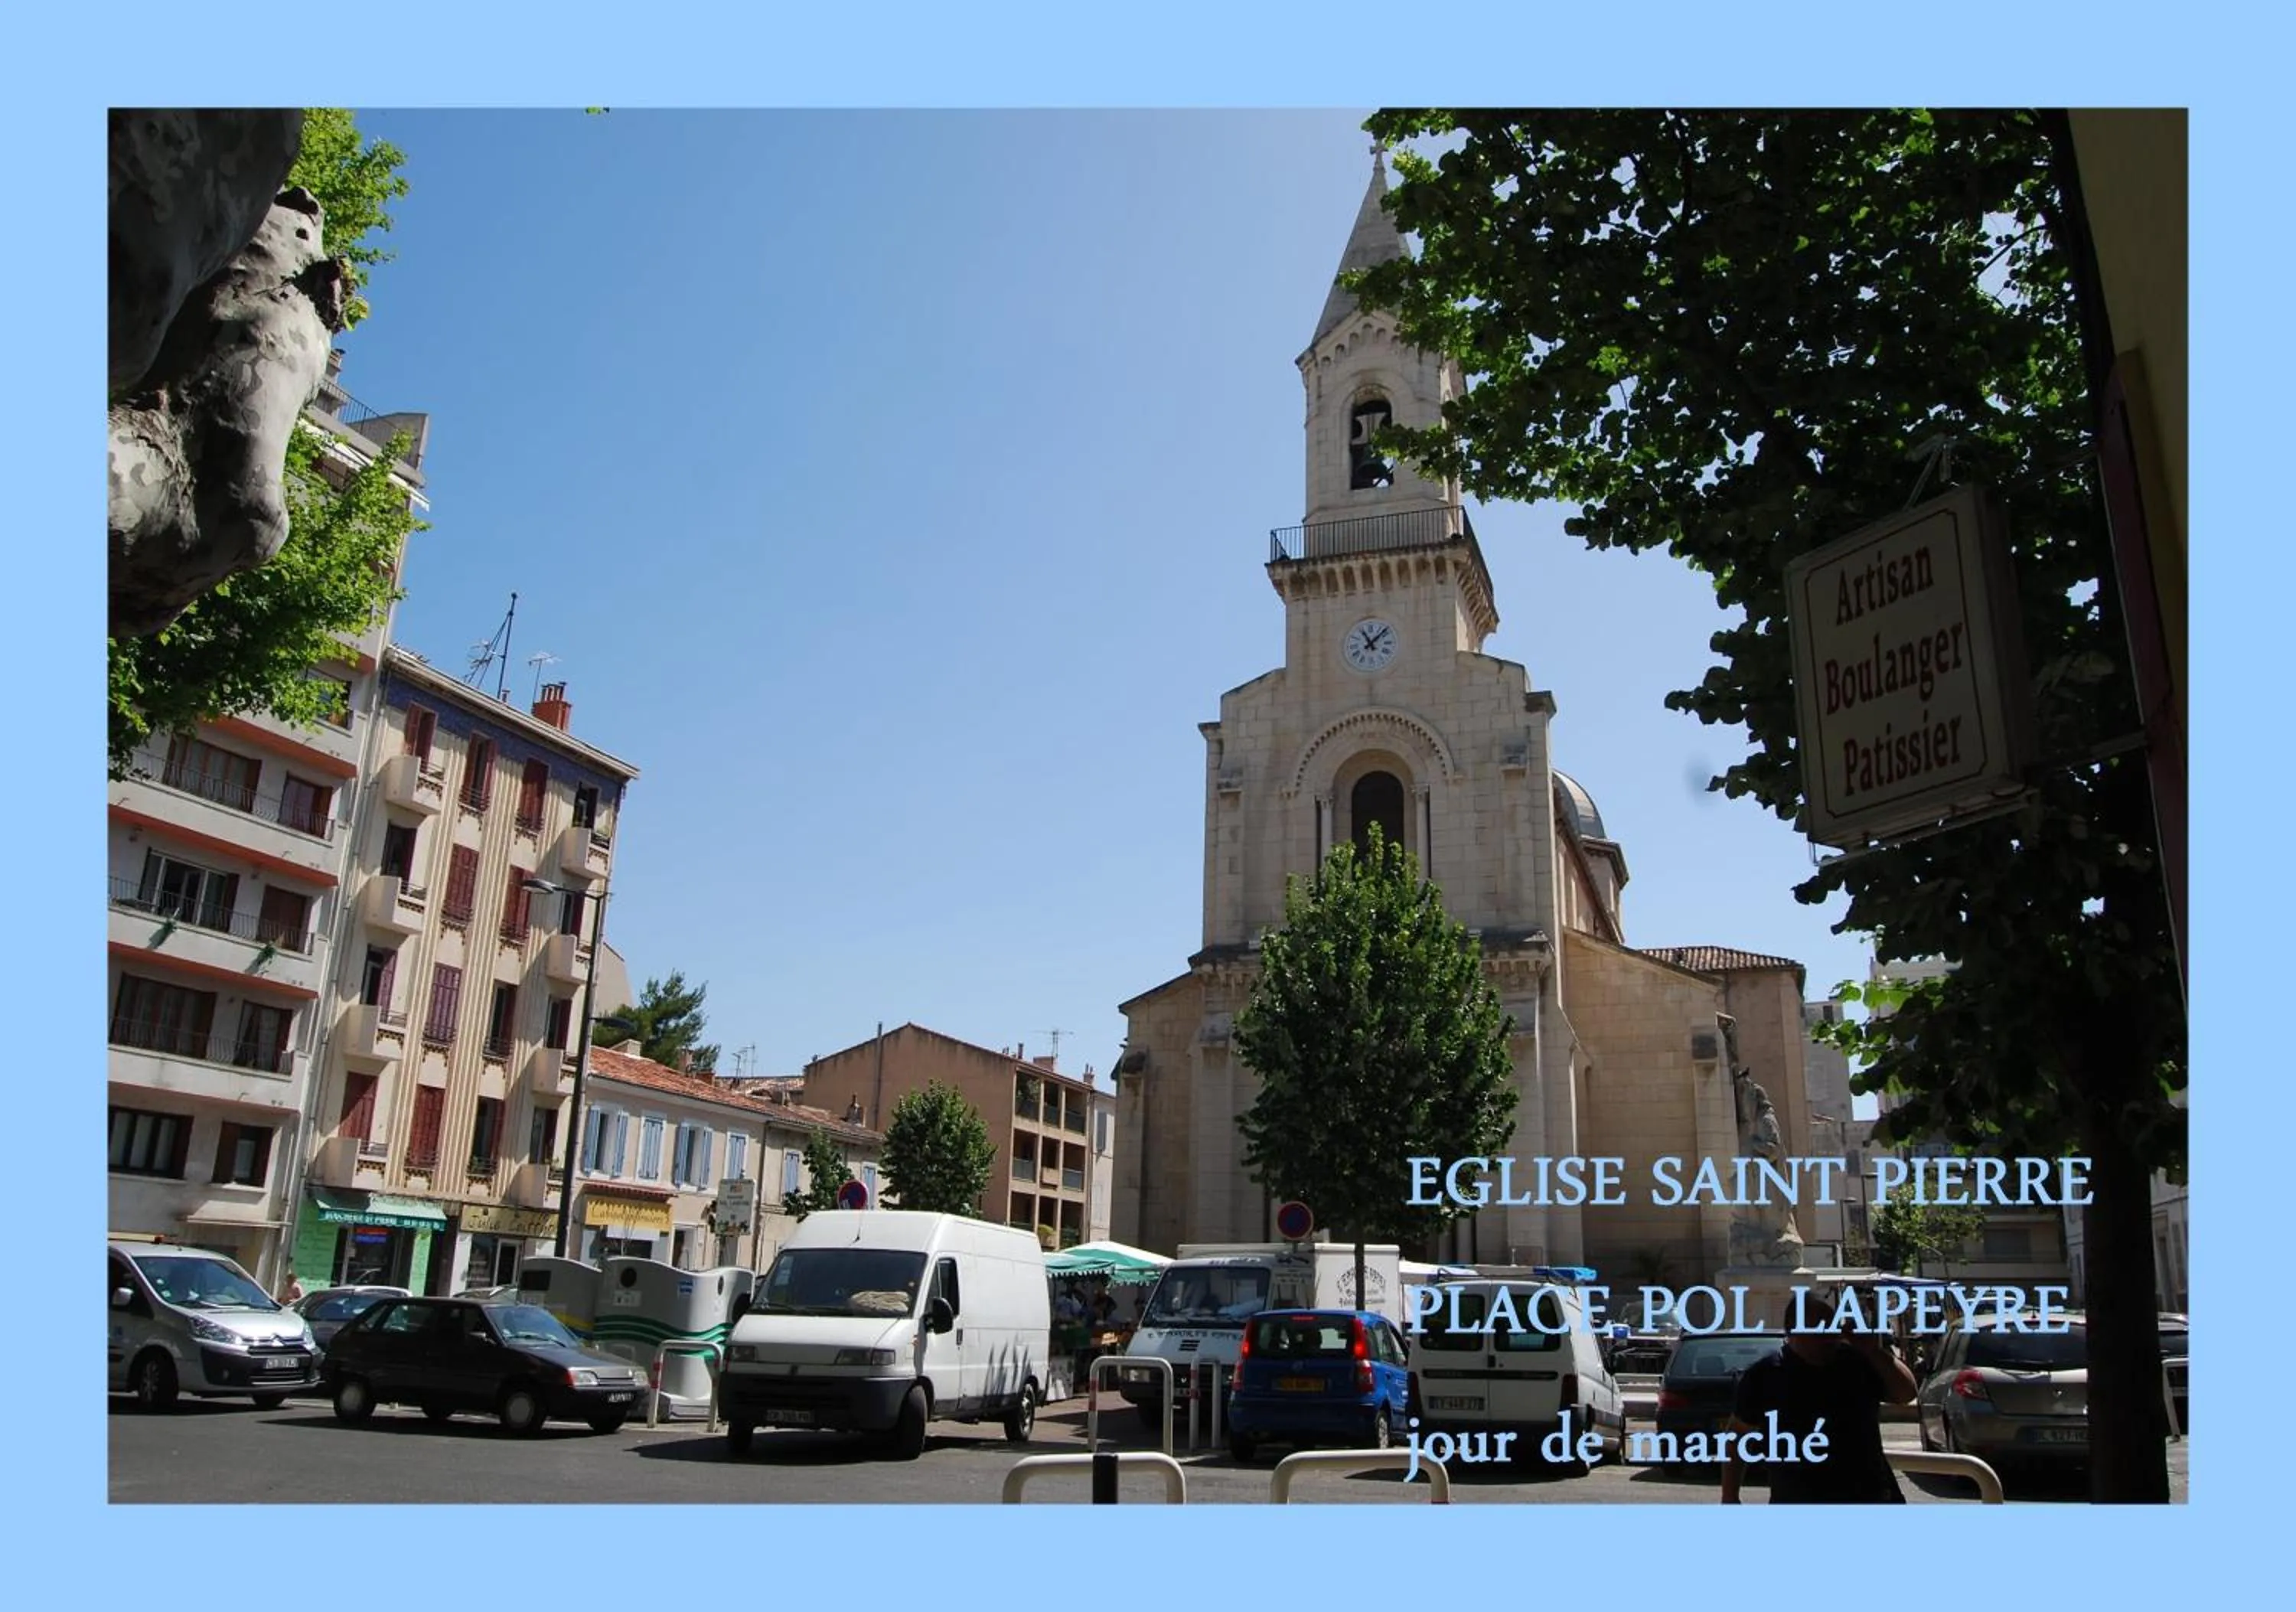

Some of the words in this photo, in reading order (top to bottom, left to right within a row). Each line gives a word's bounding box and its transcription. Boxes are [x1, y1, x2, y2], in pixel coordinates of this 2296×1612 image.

[1837, 544, 1933, 625] Artisan
[1825, 622, 1962, 715] Boulanger
[1844, 710, 1962, 796] Patissier
